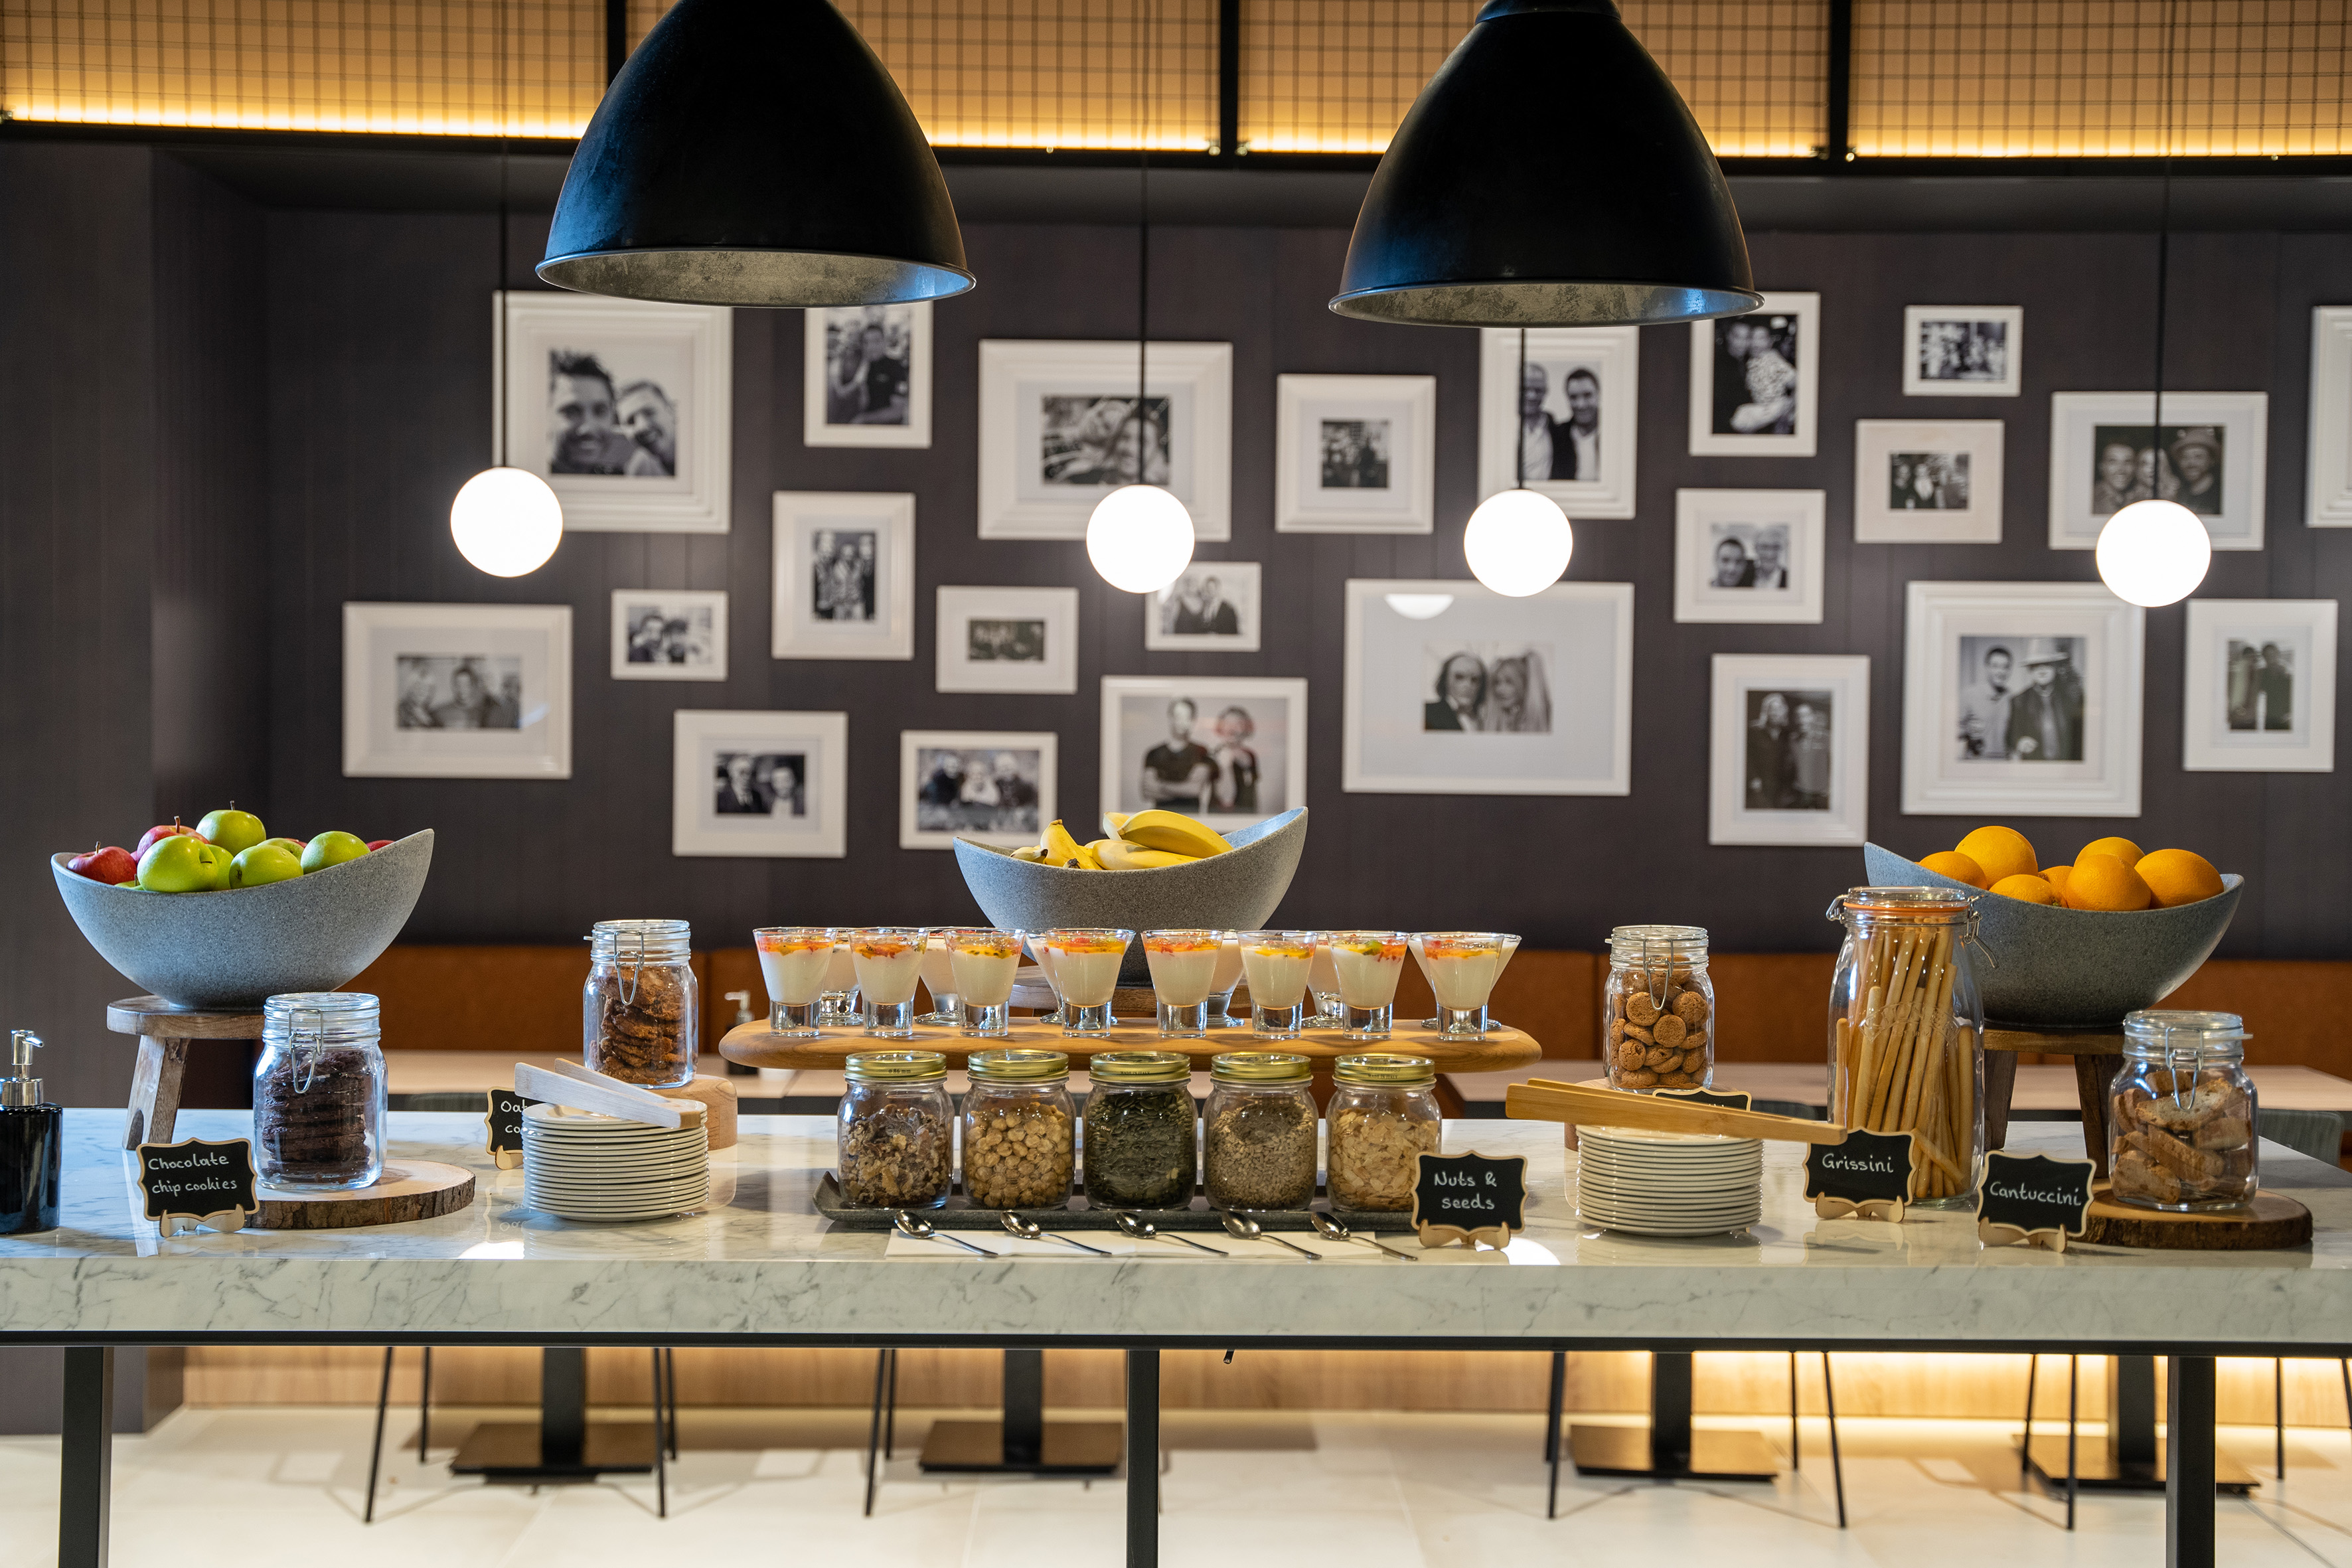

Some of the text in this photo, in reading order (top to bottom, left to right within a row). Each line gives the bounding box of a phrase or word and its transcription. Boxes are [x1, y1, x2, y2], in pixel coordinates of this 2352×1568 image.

[148, 1152, 230, 1170] Chocolate
[1822, 1152, 1895, 1174] Grissini
[151, 1176, 238, 1197] chip cookies
[1434, 1170, 1497, 1187] Nuts &
[1442, 1192, 1495, 1210] seeds
[1990, 1180, 2082, 1207] Cantuccini
